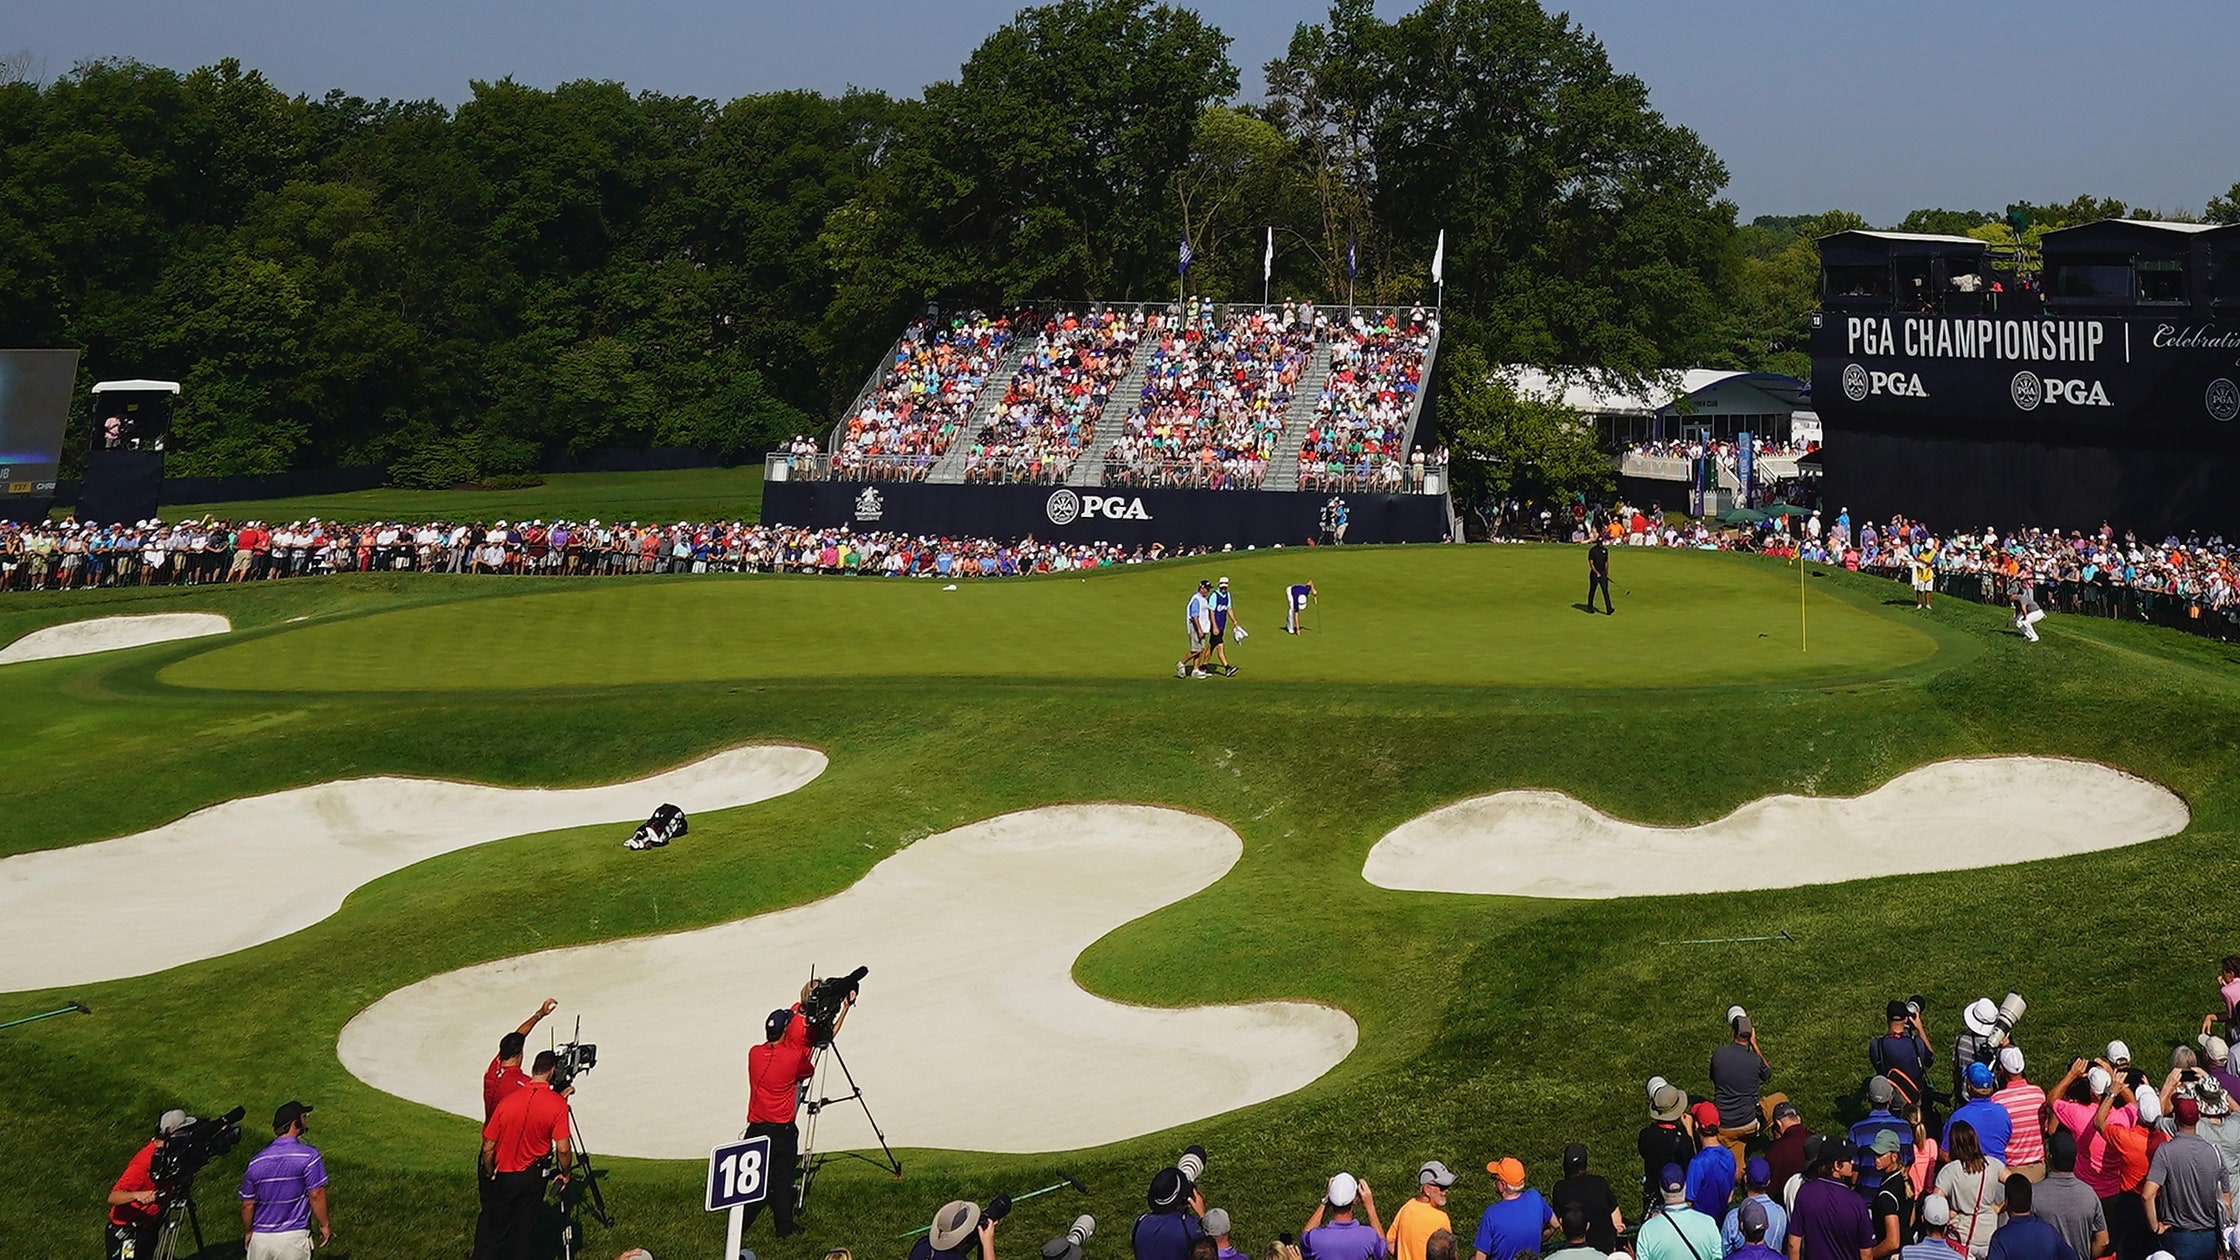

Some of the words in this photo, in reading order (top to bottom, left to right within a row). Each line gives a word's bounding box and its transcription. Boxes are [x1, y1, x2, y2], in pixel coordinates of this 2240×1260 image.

[719, 150, 762, 198] 18
[1813, 316, 1820, 325] 18
[1848, 317, 1895, 355] PGA
[1904, 318, 2104, 361] CHAMPIONSHIP
[2152, 322, 2240, 348] Celebratin
[1869, 371, 1927, 397] PGA
[2044, 378, 2112, 406] PGA
[2212, 395, 2234, 404] PGA
[1081, 495, 1149, 519] PGA
